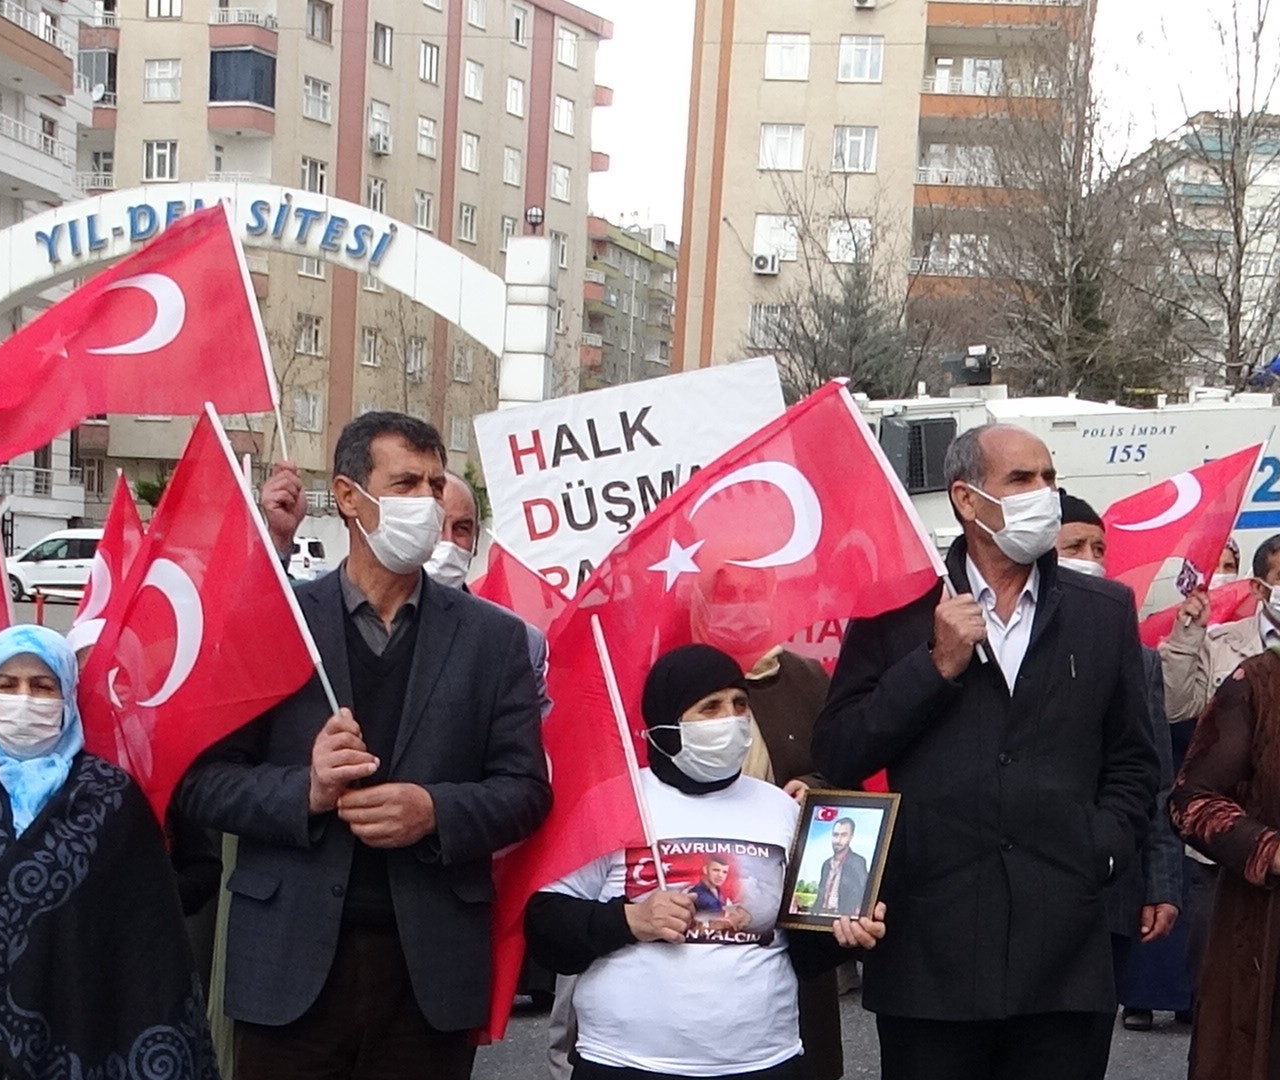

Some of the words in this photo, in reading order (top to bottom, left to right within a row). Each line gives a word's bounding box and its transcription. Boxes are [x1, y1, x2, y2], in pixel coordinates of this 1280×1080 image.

[35, 198, 223, 264] YIL-DE
[245, 192, 399, 268] SİTESİ
[507, 405, 663, 476] HALK
[1082, 424, 1124, 438] POLİS
[1130, 423, 1177, 437] İMDAT
[1105, 443, 1148, 464] 155
[523, 464, 703, 542] DÜŞM
[661, 842, 731, 855] YAVRUM
[735, 844, 770, 858] DÖN
